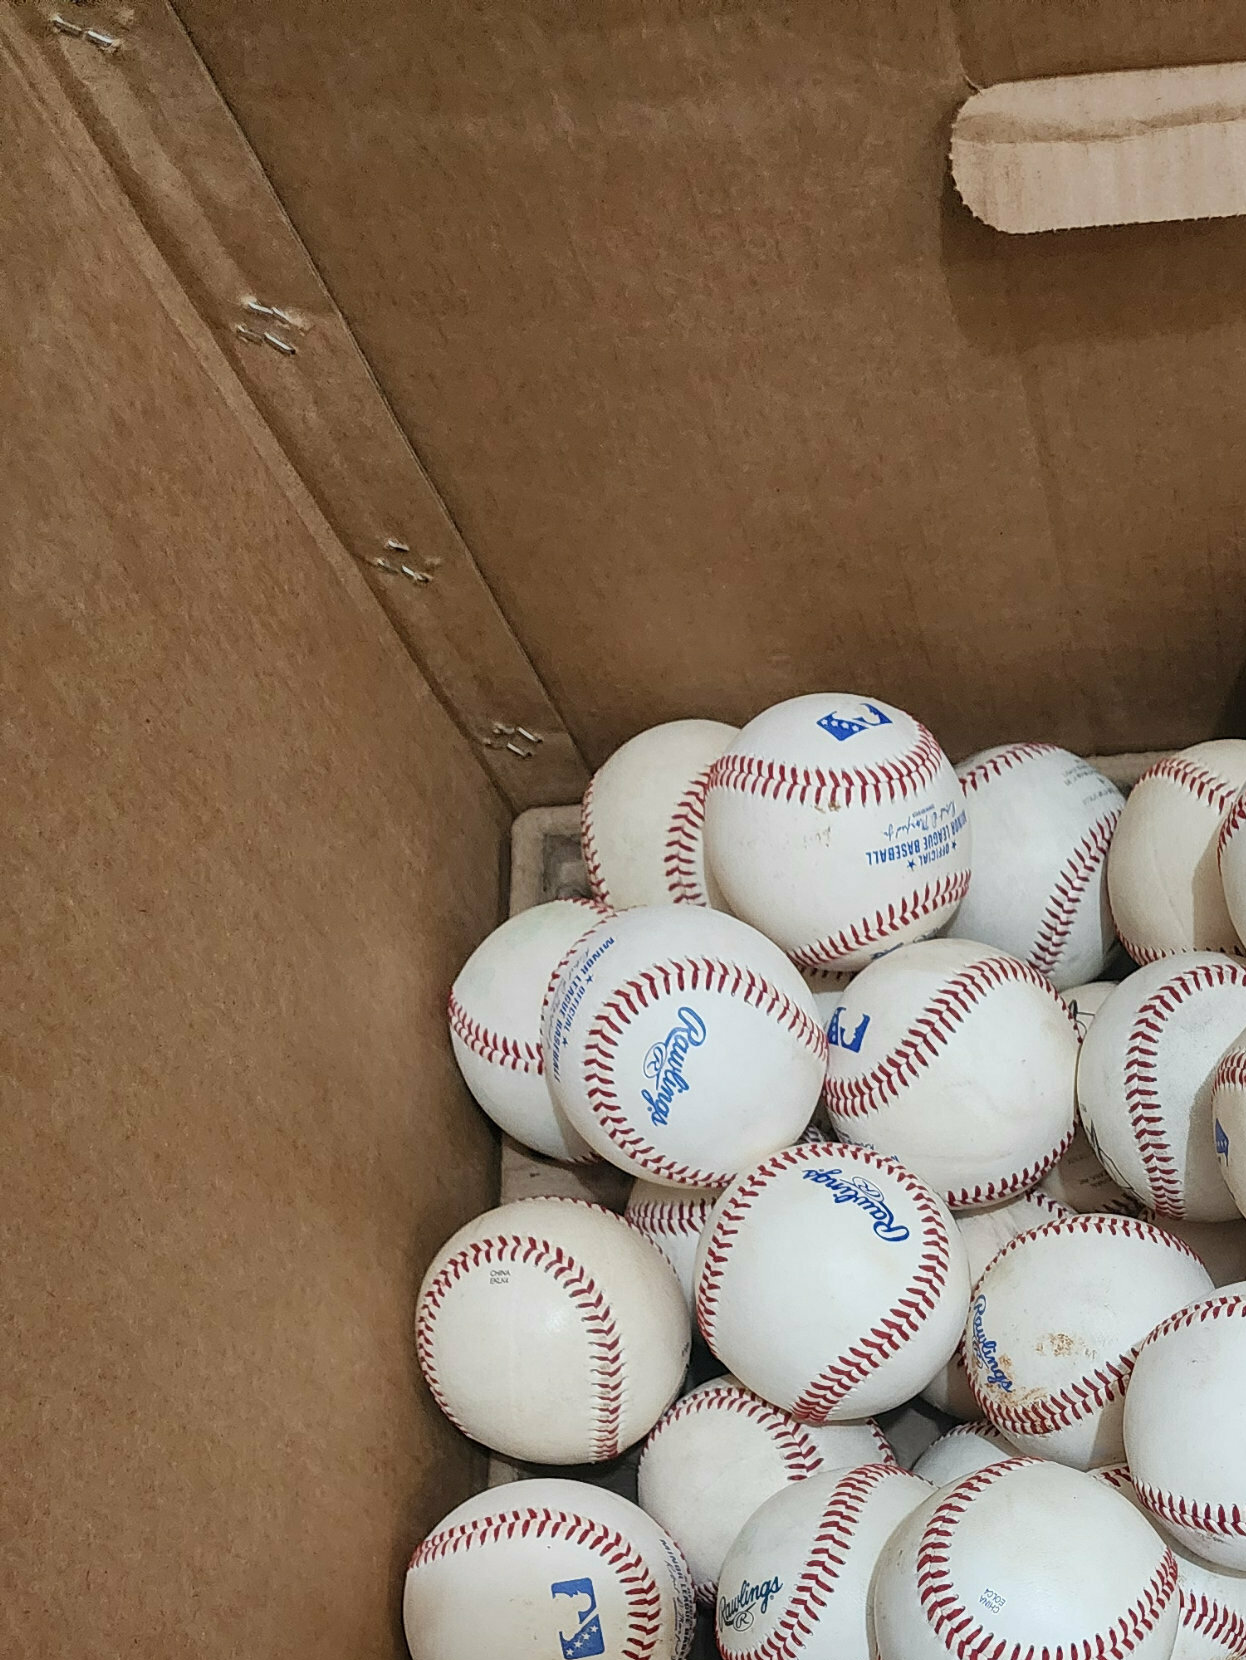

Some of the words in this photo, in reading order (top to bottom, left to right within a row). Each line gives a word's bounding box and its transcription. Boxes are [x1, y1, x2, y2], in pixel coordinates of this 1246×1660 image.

[865, 839, 921, 867] BASEBALL
[919, 843, 950, 867] OFFICIAL
[923, 826, 949, 851] LEAGUE
[580, 937, 615, 976] MINOR
[566, 986, 587, 1033] OFFICIAL
[641, 1006, 707, 1127] Rawlings
[802, 1168, 910, 1242] Rawlings
[971, 1294, 1013, 1394] Rawlings
[718, 1576, 783, 1632] Rawlings
[979, 1595, 1000, 1614] CHINA
[984, 1588, 1006, 1607] EOLCA
